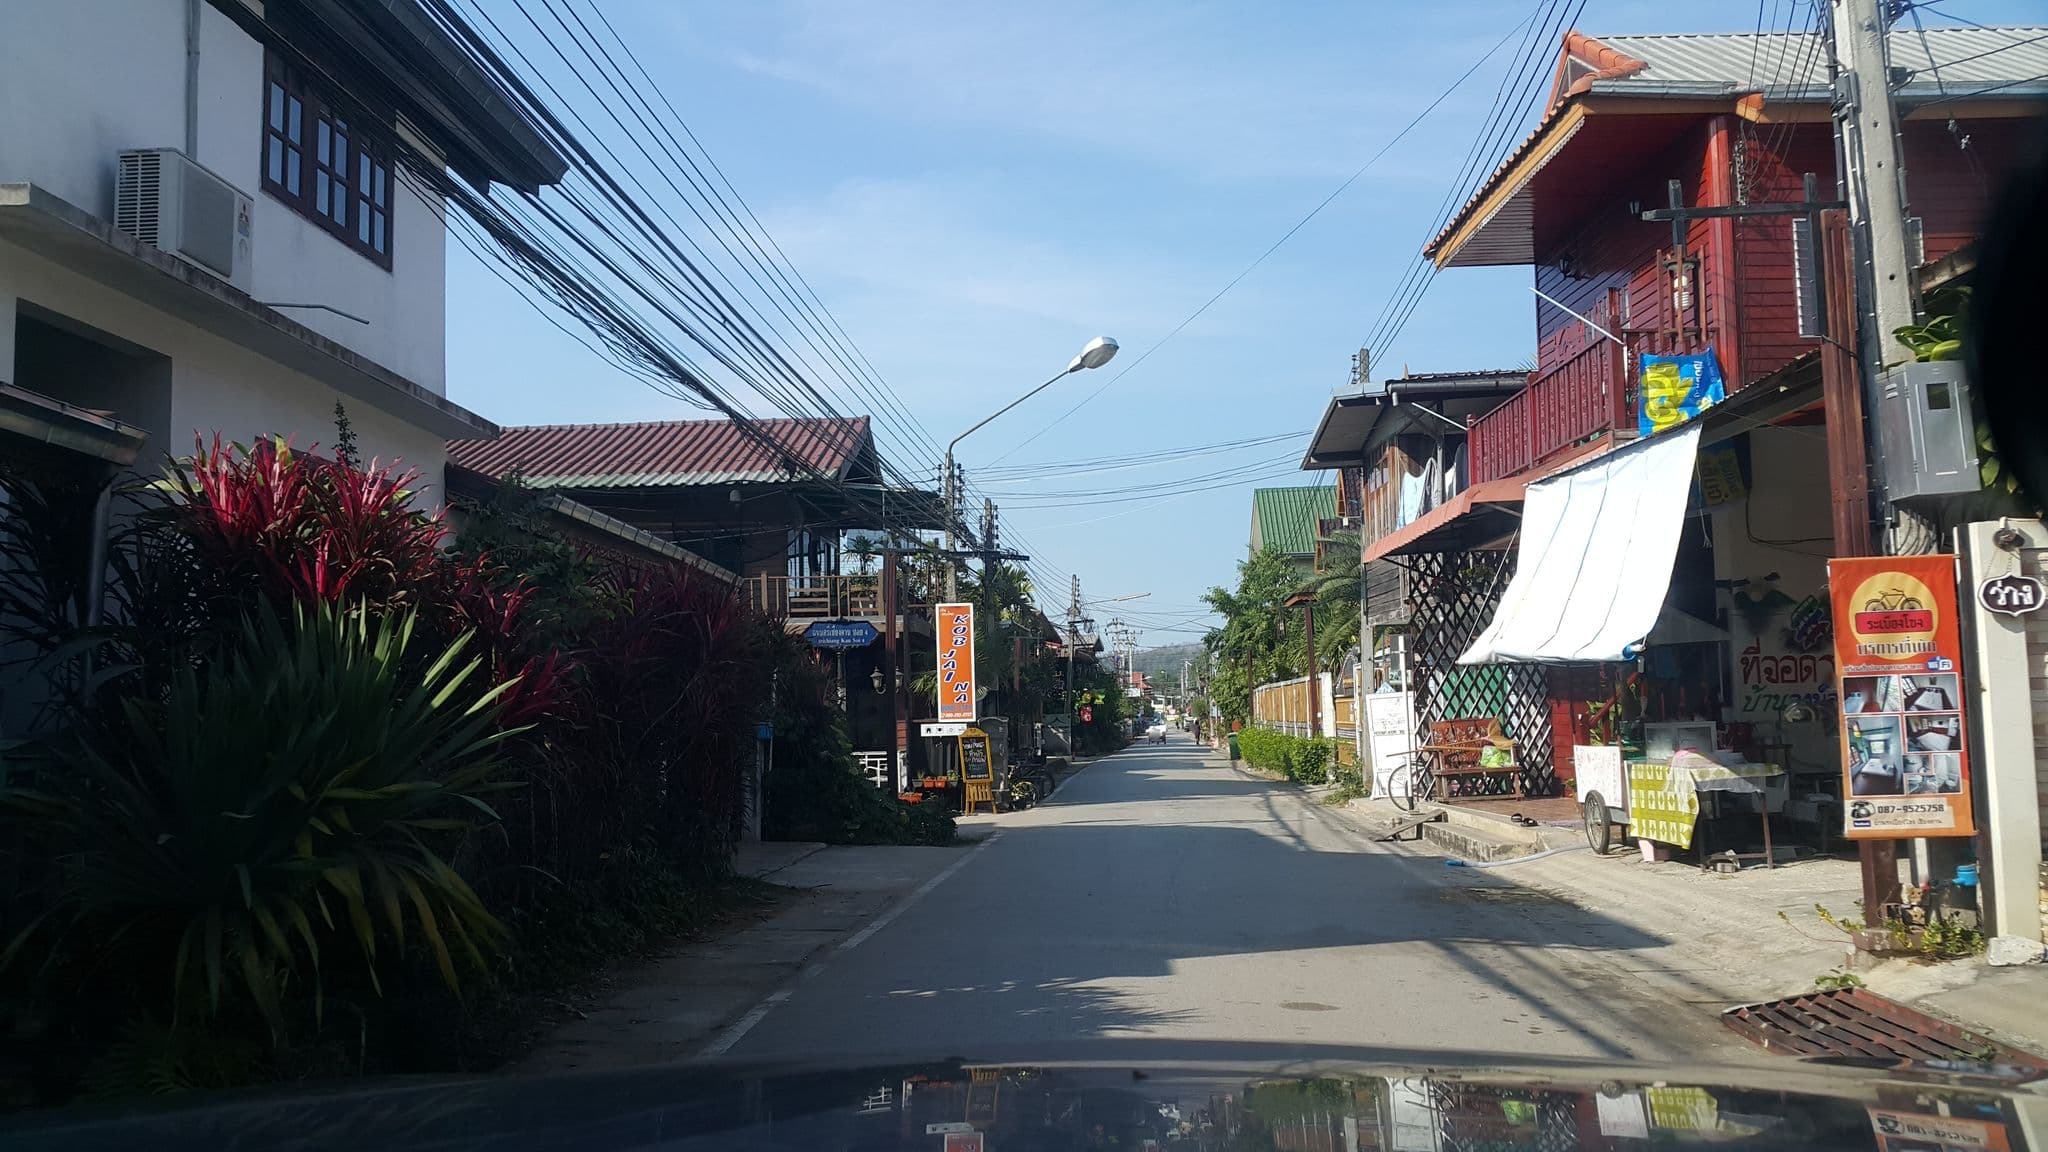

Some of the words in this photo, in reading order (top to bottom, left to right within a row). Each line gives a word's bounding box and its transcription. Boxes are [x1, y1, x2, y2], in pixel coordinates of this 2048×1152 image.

[1989, 580, 2034, 606] ว่าง
[952, 614, 969, 647] KOB
[941, 649, 957, 683] JAI
[953, 681, 970, 703] NA
[1877, 804, 1945, 814] 087-9525758
